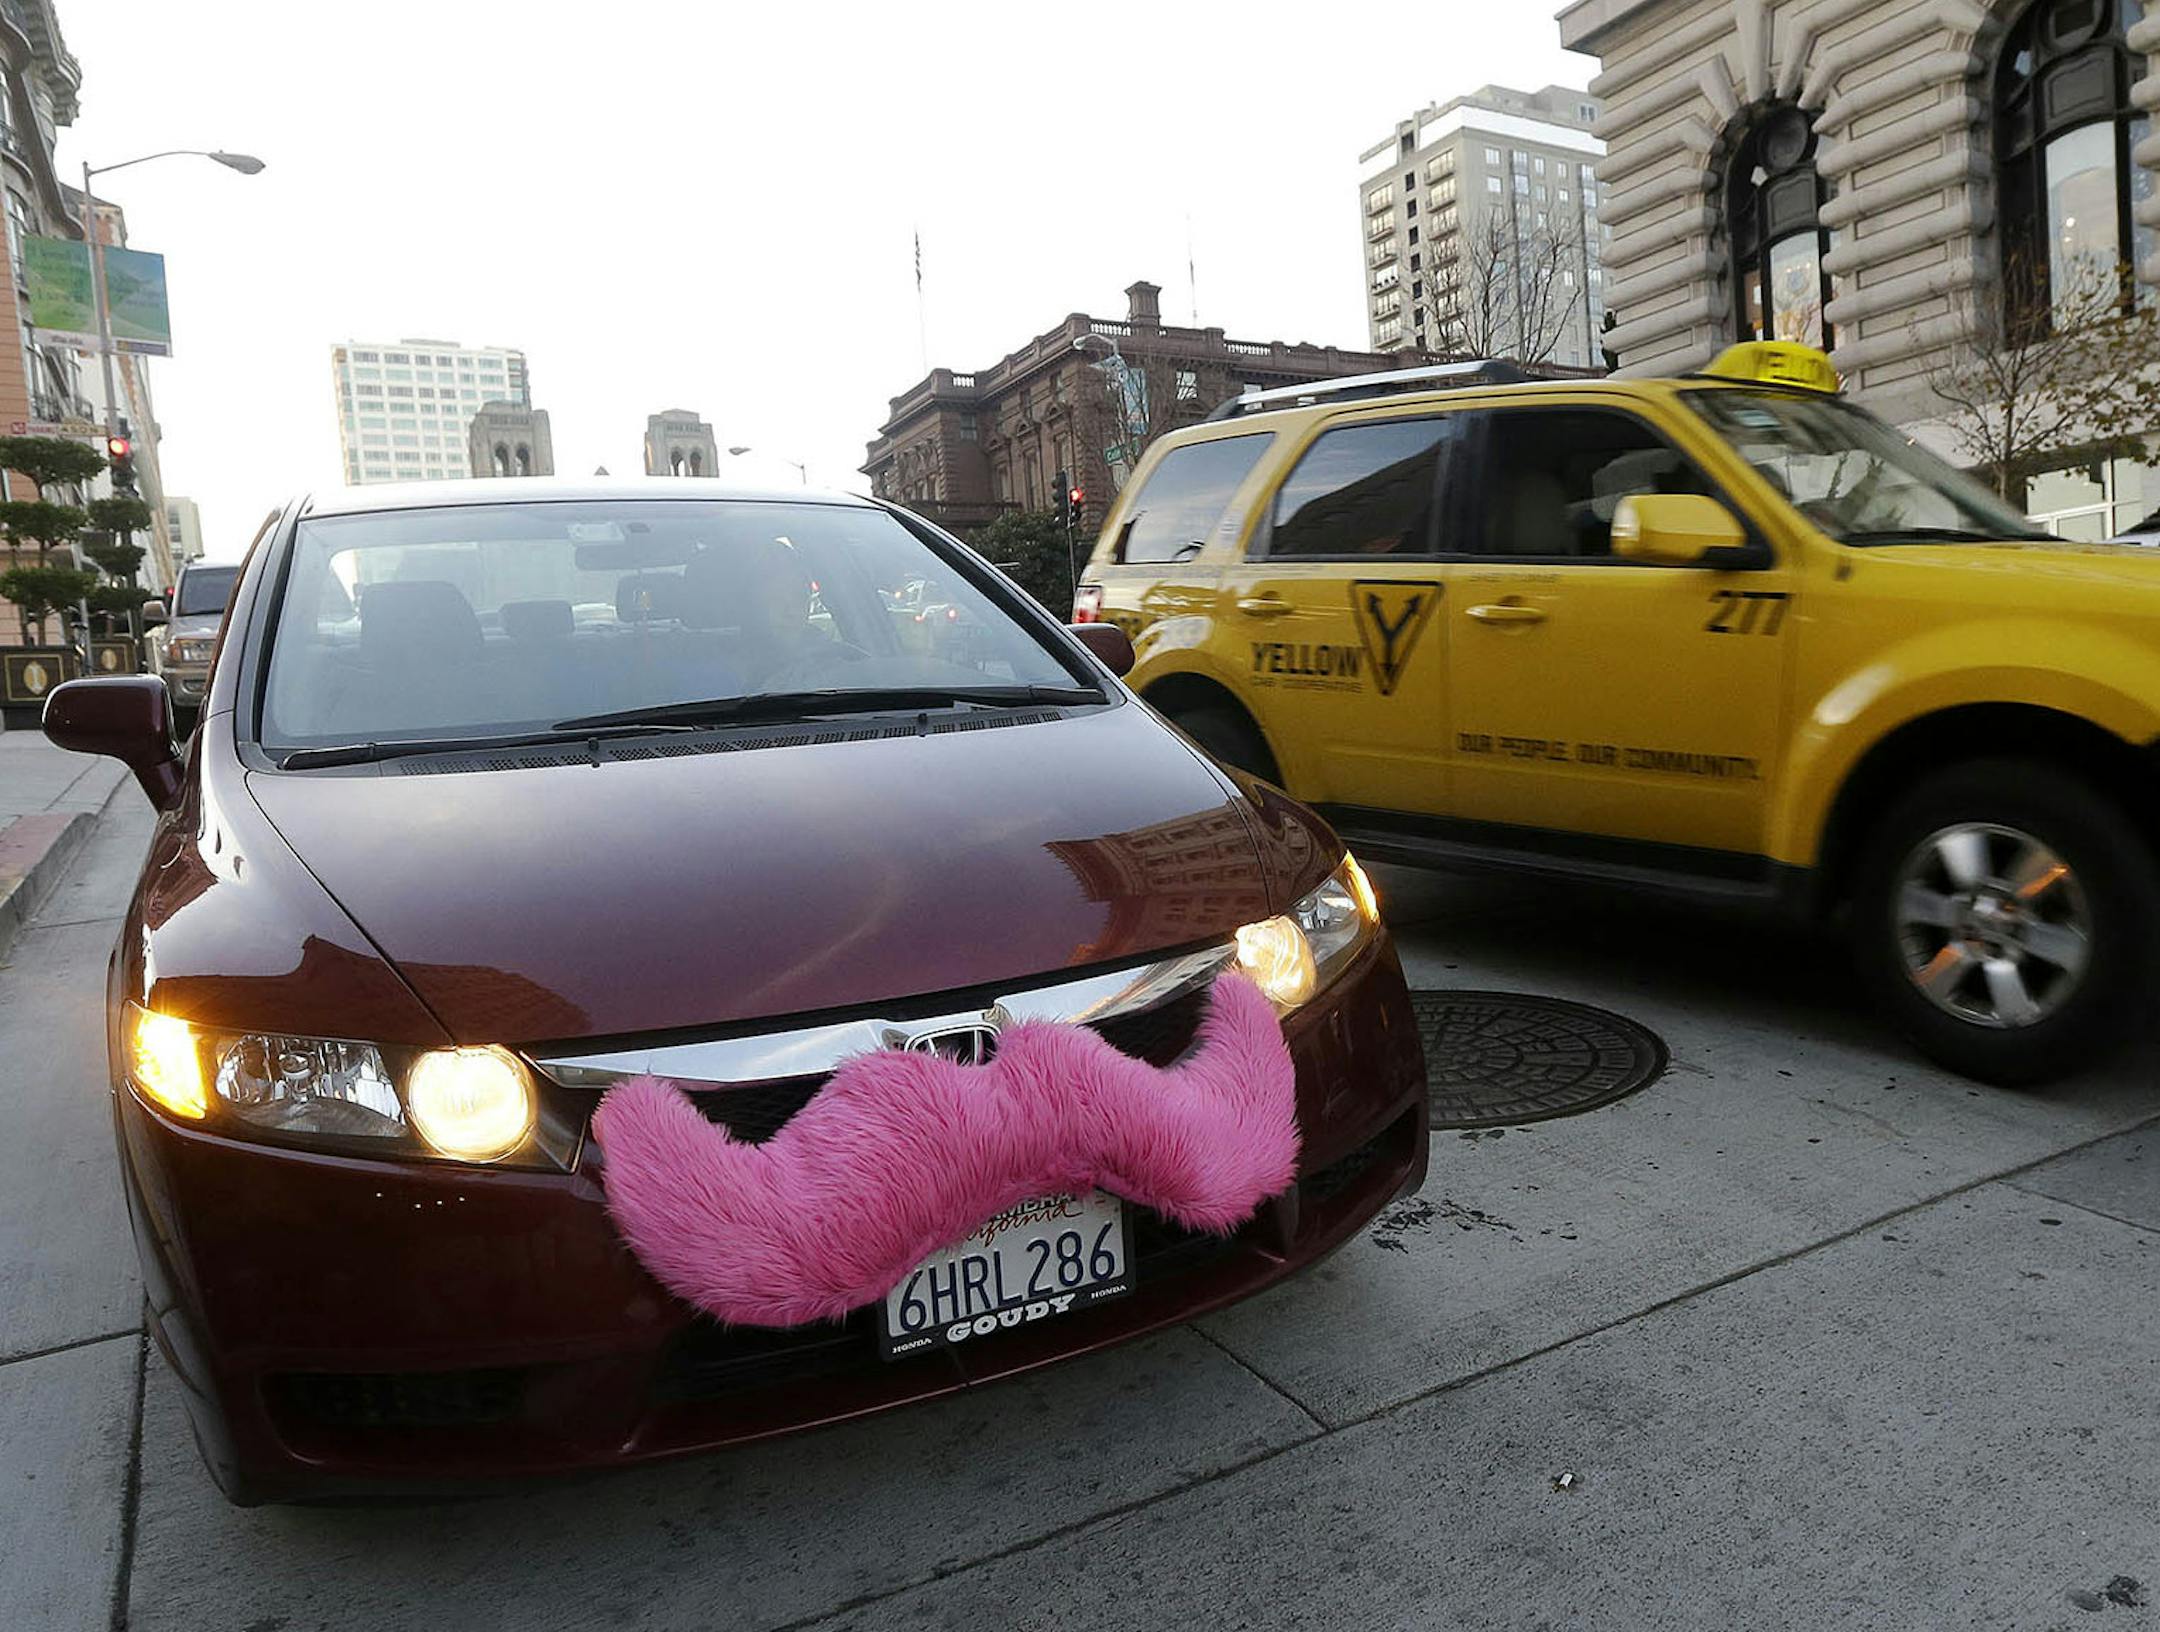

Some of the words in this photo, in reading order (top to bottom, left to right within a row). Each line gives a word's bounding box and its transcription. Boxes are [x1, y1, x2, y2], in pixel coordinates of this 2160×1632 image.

[1705, 590, 1794, 636] 277
[1252, 643, 1363, 677] YELLOW
[1457, 733, 1493, 752] OUR
[1577, 744, 1618, 766] OUR
[899, 1250, 1024, 1333] 6HRL
[1026, 1221, 1115, 1299] 286
[1090, 1284, 1127, 1299] HONDA
[945, 1293, 1077, 1343] GOUDY
[892, 1337, 932, 1354] HONDA
